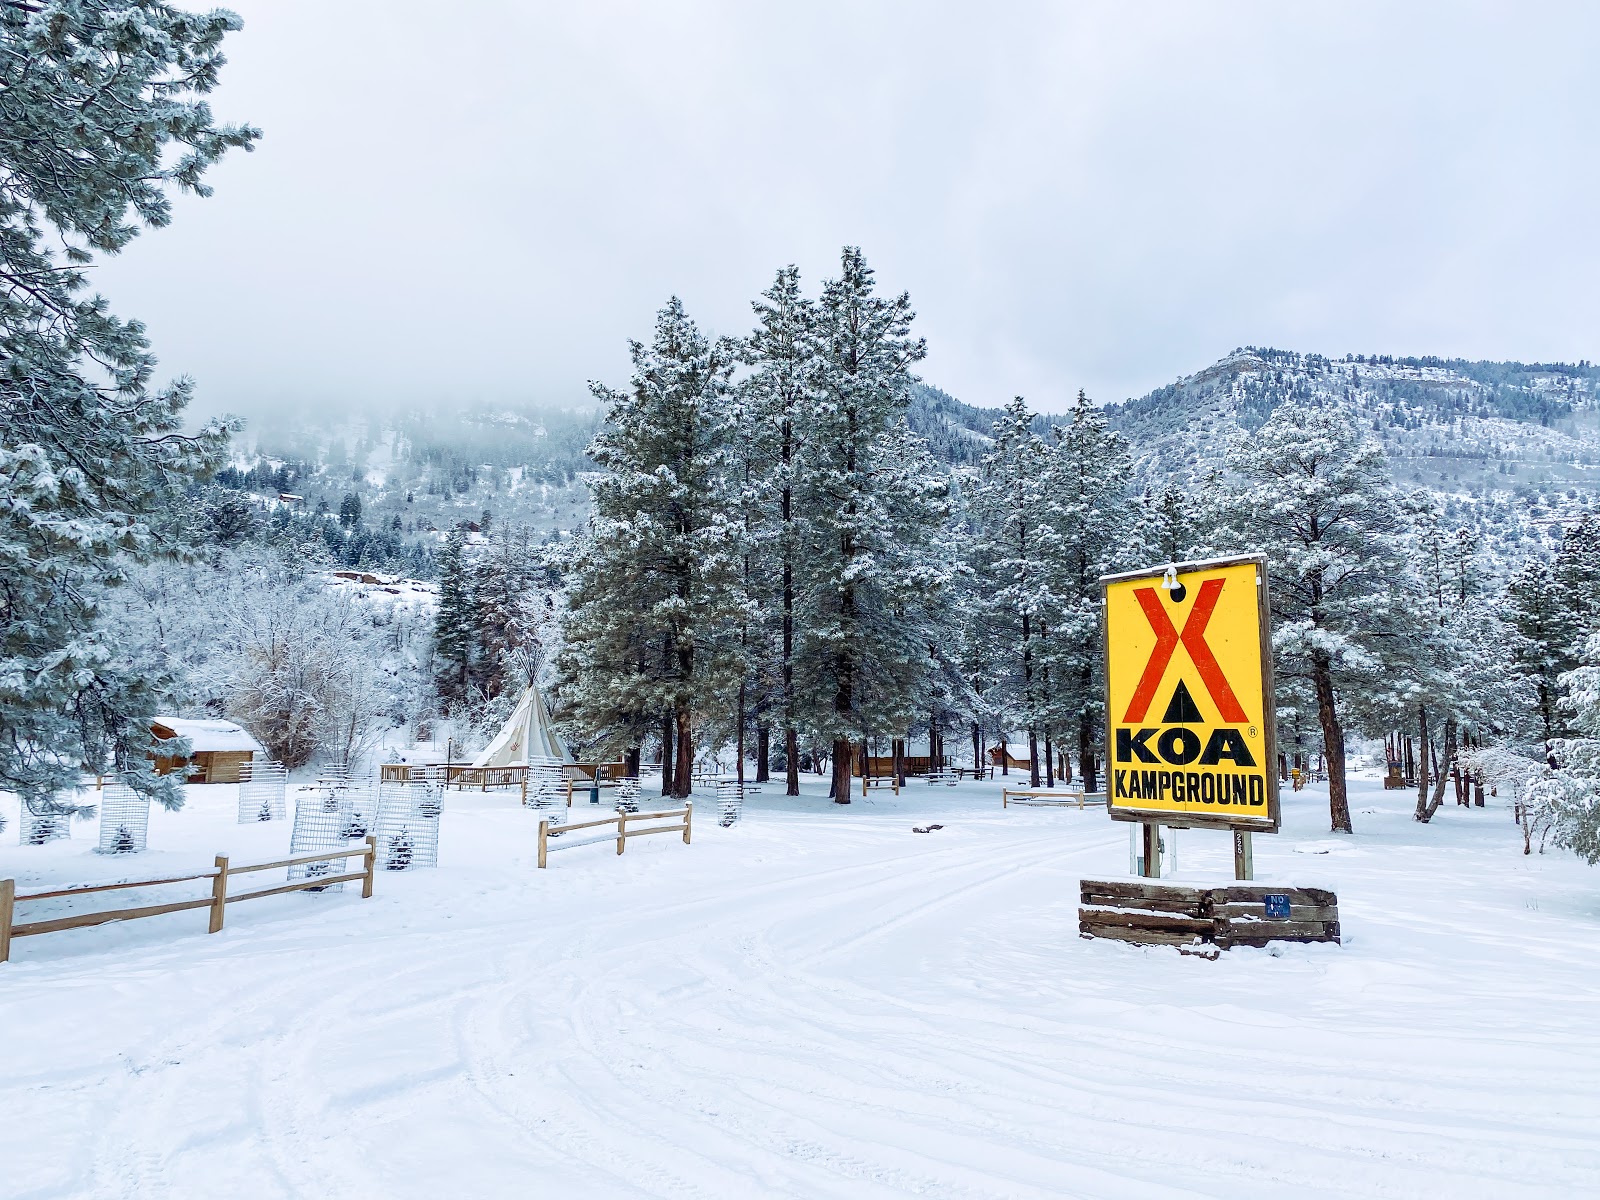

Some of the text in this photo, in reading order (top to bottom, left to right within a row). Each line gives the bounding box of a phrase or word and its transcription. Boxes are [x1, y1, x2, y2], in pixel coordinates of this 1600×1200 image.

[1115, 727, 1257, 767] KOA
[1114, 769, 1264, 806] KAMPGROUND
[1270, 896, 1284, 904] NO
